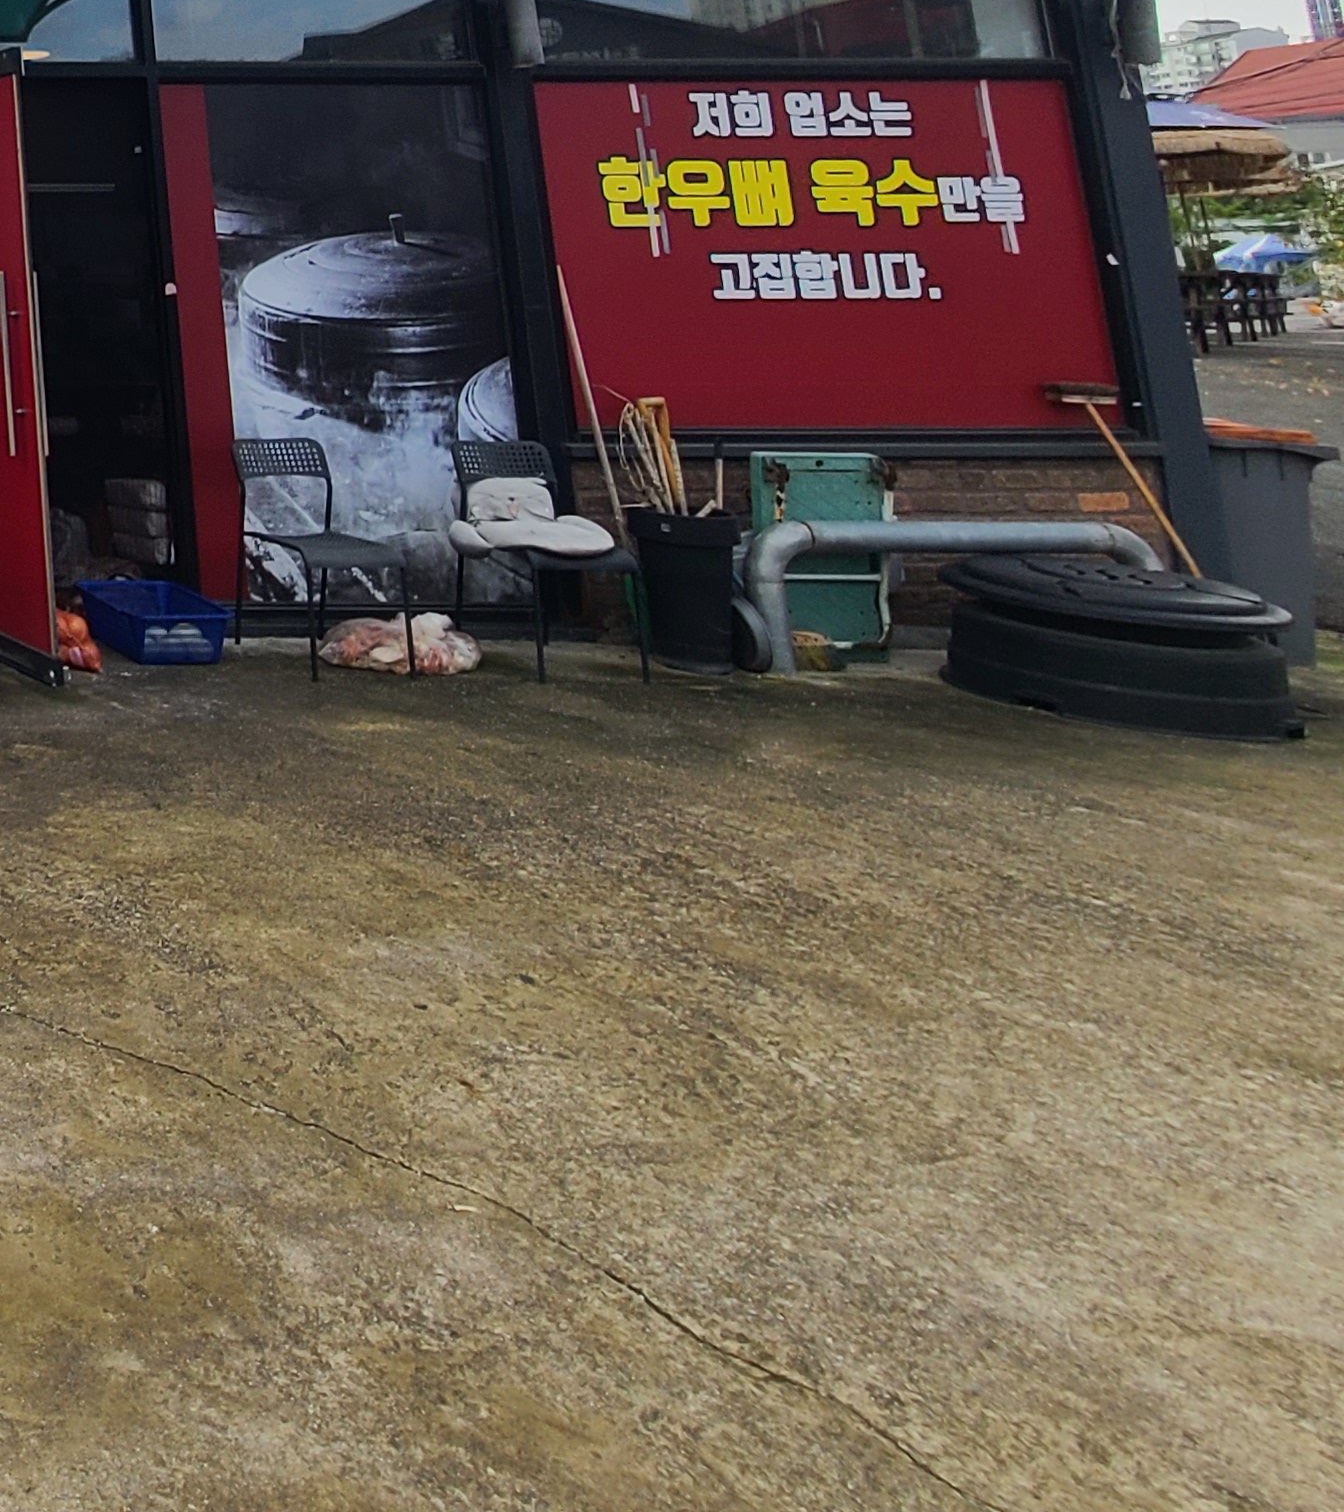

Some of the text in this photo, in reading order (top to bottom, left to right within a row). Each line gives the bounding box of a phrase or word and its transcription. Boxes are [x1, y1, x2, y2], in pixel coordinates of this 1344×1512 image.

[688, 90, 913, 137] 저희 업소는
[598, 156, 1025, 227] 한우뼈 육수만을
[710, 250, 942, 300] 고집합니다.
